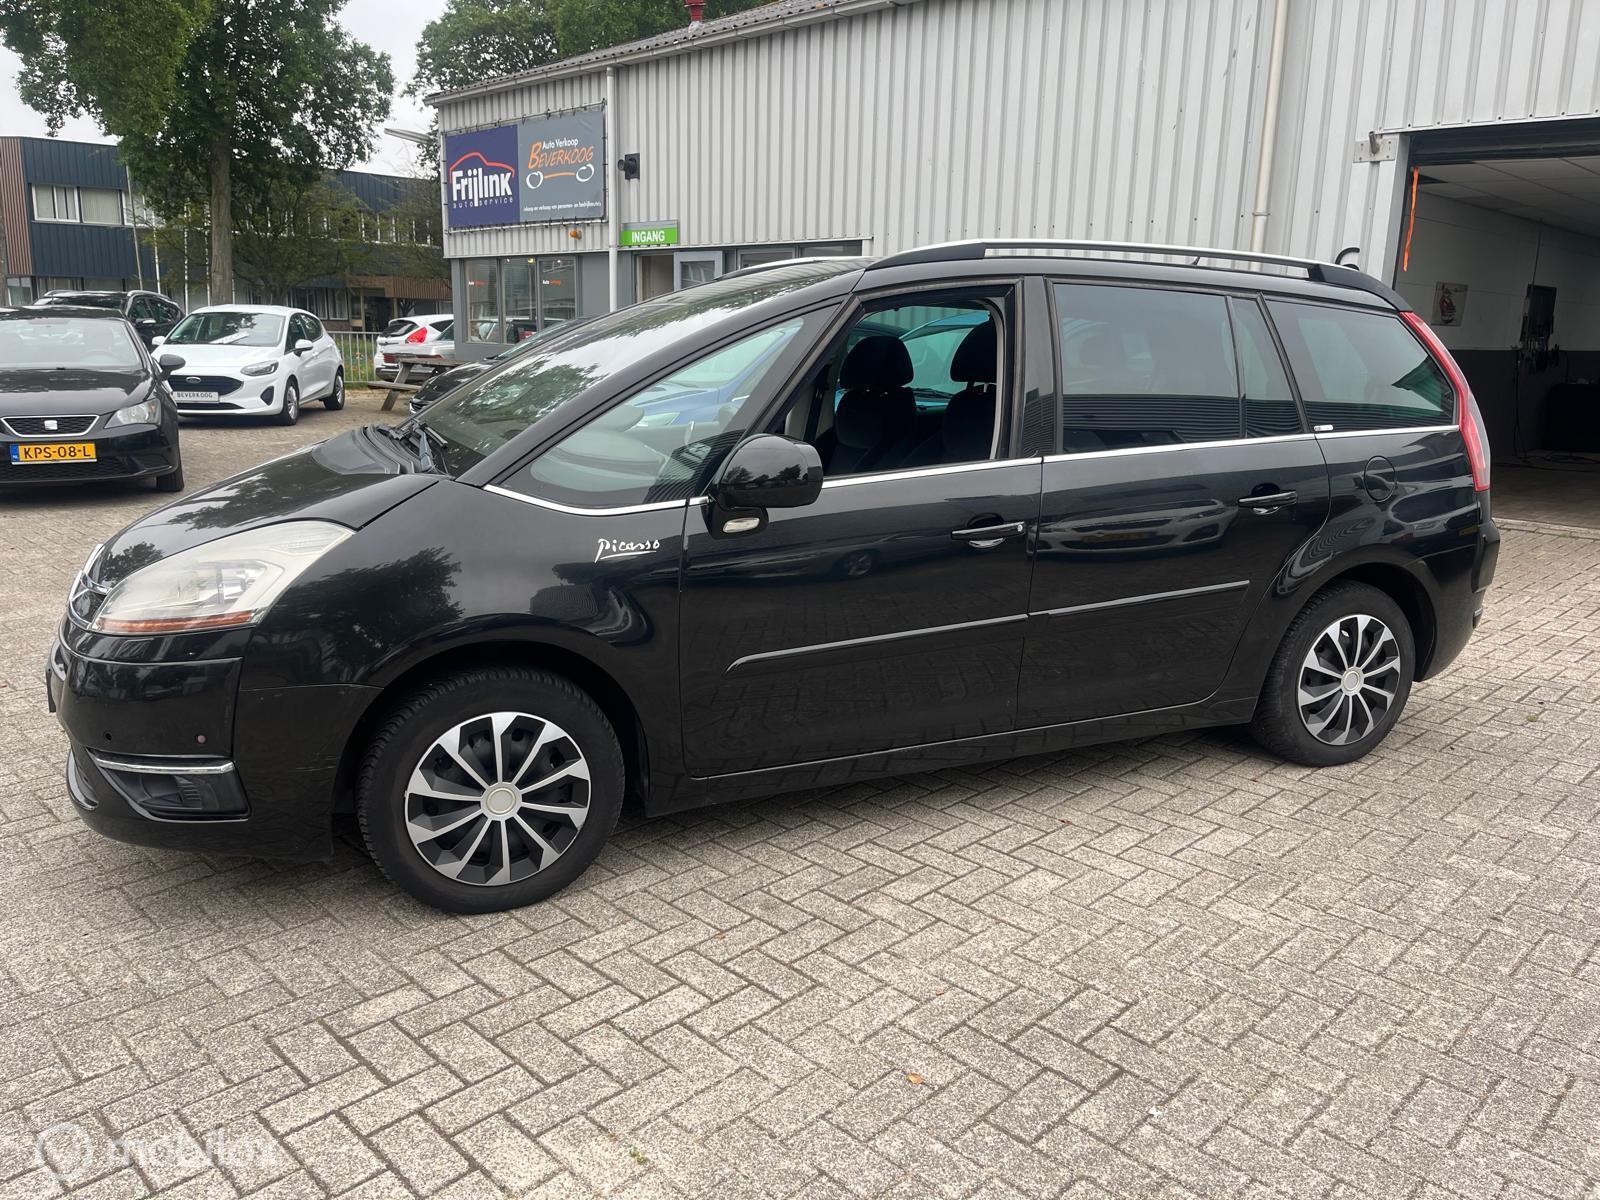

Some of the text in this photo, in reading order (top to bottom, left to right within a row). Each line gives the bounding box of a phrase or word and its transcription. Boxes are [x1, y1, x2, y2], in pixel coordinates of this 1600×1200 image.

[543, 137, 579, 150] Auto Verkoop
[452, 168, 513, 207] Frijlink
[453, 201, 474, 209] auto
[480, 197, 514, 207] service
[631, 230, 665, 243] INGANG
[23, 446, 91, 460] KPS-08-L
[594, 538, 661, 563] Picasso
